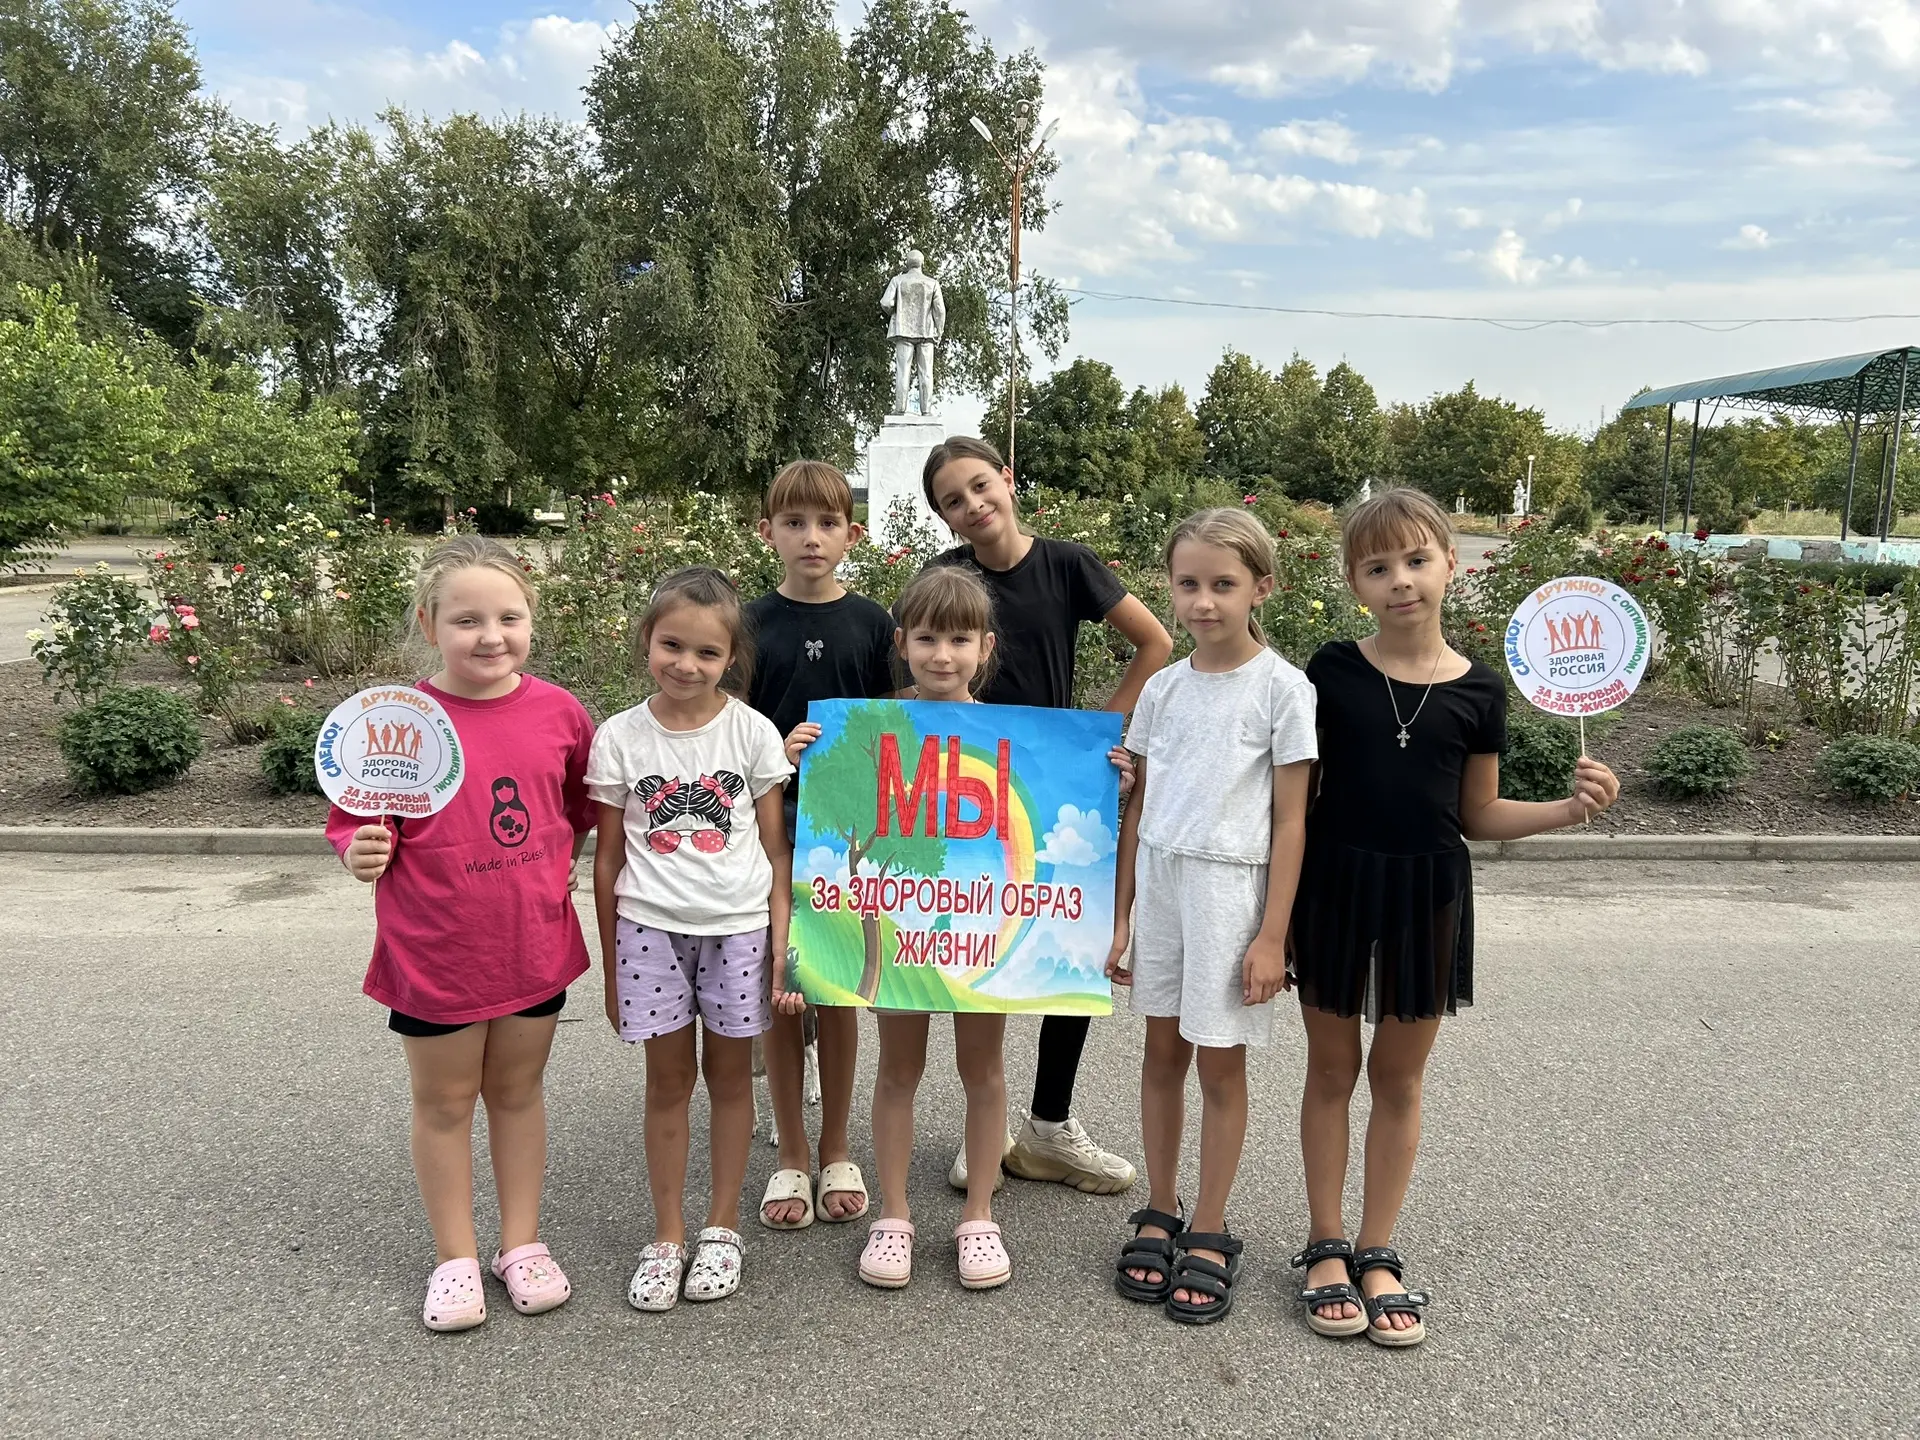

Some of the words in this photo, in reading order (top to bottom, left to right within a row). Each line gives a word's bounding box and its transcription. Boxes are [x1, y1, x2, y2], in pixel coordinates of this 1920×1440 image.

[1535, 580, 1608, 604] ДРУЖНО!
[1506, 618, 1530, 676] СМЕЛО!
[1611, 594, 1622, 602] С
[1620, 600, 1646, 675] ОПТИМИЗМОМ!
[1549, 652, 1604, 666] ЗДОРОВАЯ
[1550, 662, 1606, 678] РОССИЯ
[360, 690, 436, 716] ДРУЖНО!
[1532, 695, 1575, 713] ОБРАЗ
[1578, 688, 1630, 713] ЖИЗНИ
[1536, 686, 1552, 698] ЗА
[1556, 678, 1625, 703] ЗДОРОВЫЙ
[436, 718, 446, 726] С
[319, 722, 344, 778] СМЕЛО!
[433, 728, 460, 794] ОПТИМИЗМОМ!
[362, 758, 419, 771] ЗДОРОВАЯ
[362, 768, 418, 782] РОССИЯ
[344, 786, 360, 797] ЗА
[362, 791, 430, 804] ЗДОРОВЫЙ
[876, 732, 1010, 841] МЫ
[338, 796, 380, 810] ОБРАЗ
[384, 802, 432, 814] ЖИЗНИ
[464, 858, 502, 874] Made
[506, 856, 516, 868] in
[812, 877, 840, 910] За
[848, 875, 994, 918] ЗДОРОВЫЙ
[1001, 884, 1082, 920] ОБРАЗ
[894, 930, 997, 968] ЖИЗНИ!
